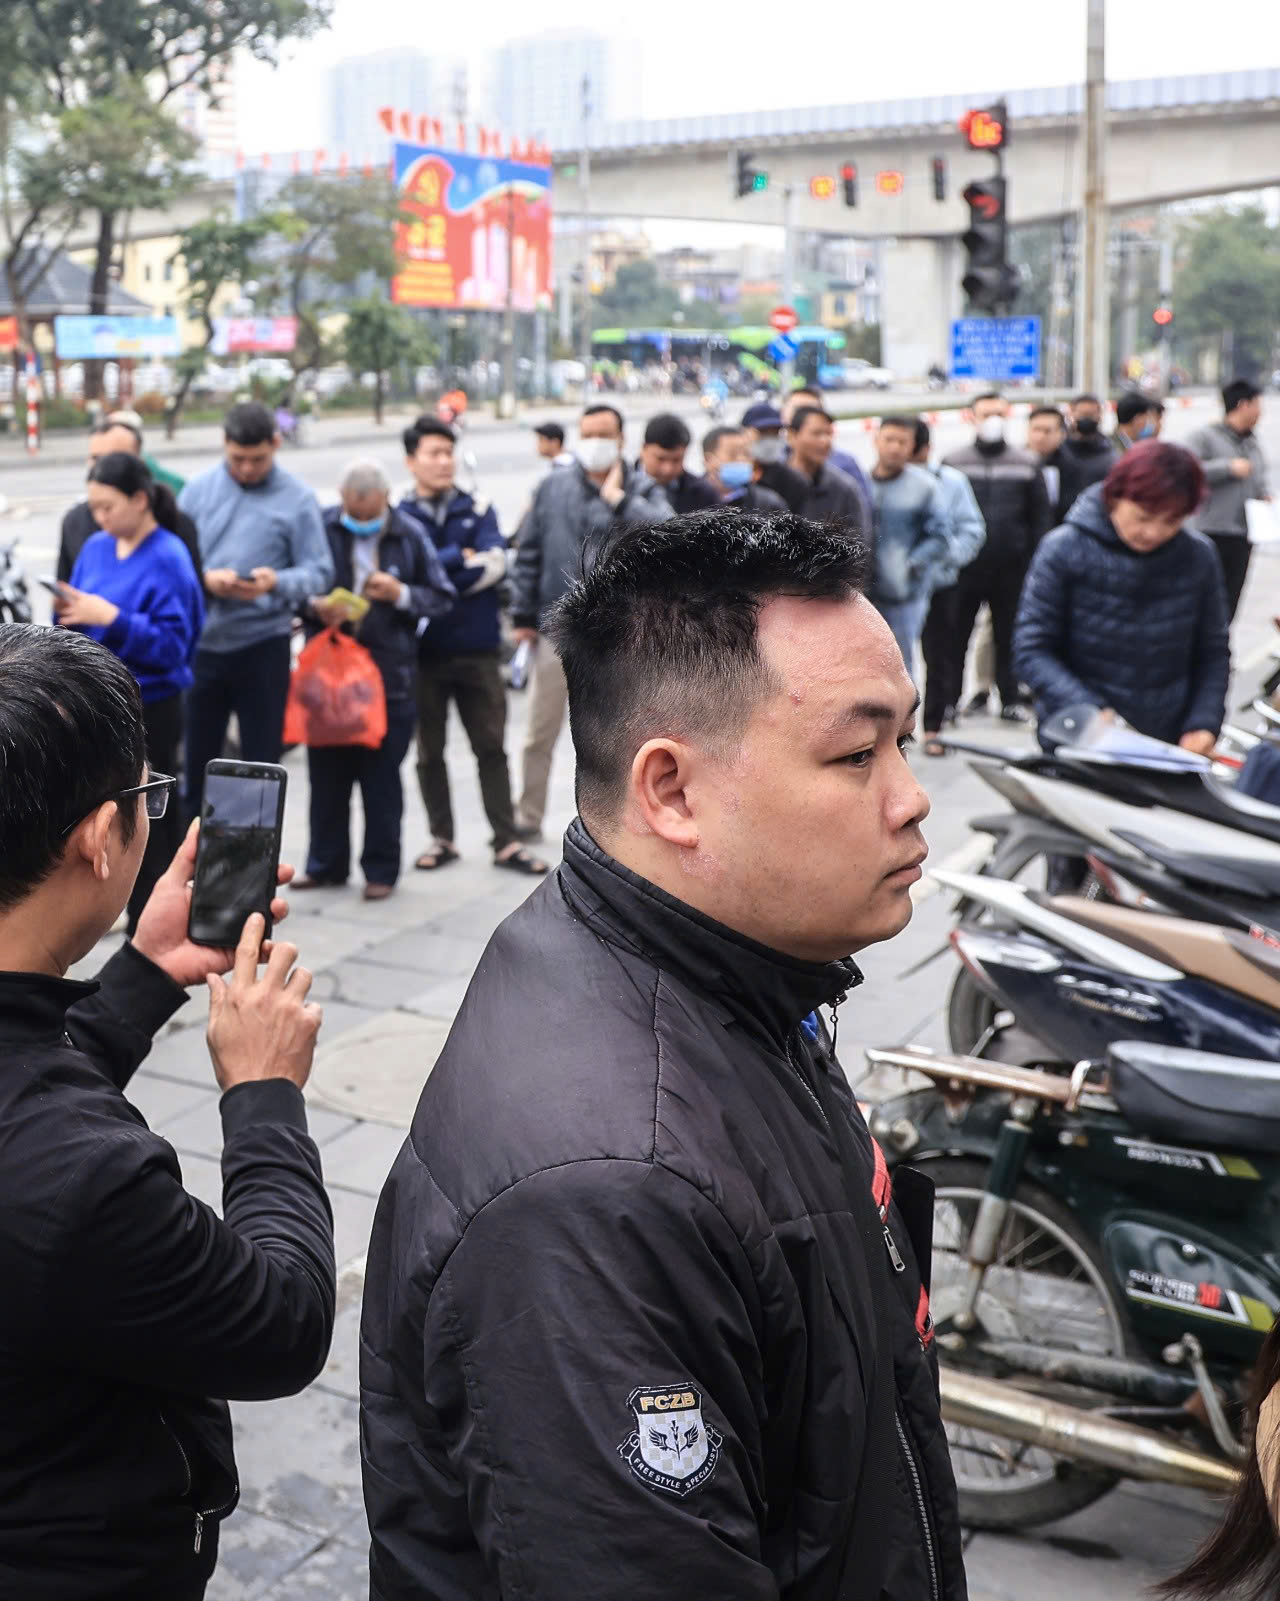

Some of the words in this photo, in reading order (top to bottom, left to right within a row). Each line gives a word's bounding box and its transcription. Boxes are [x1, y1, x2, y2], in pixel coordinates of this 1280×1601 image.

[640, 1392, 695, 1411] FCZB
[655, 1474, 681, 1489] STYLE
[685, 1448, 717, 1489] SPECIALIST
